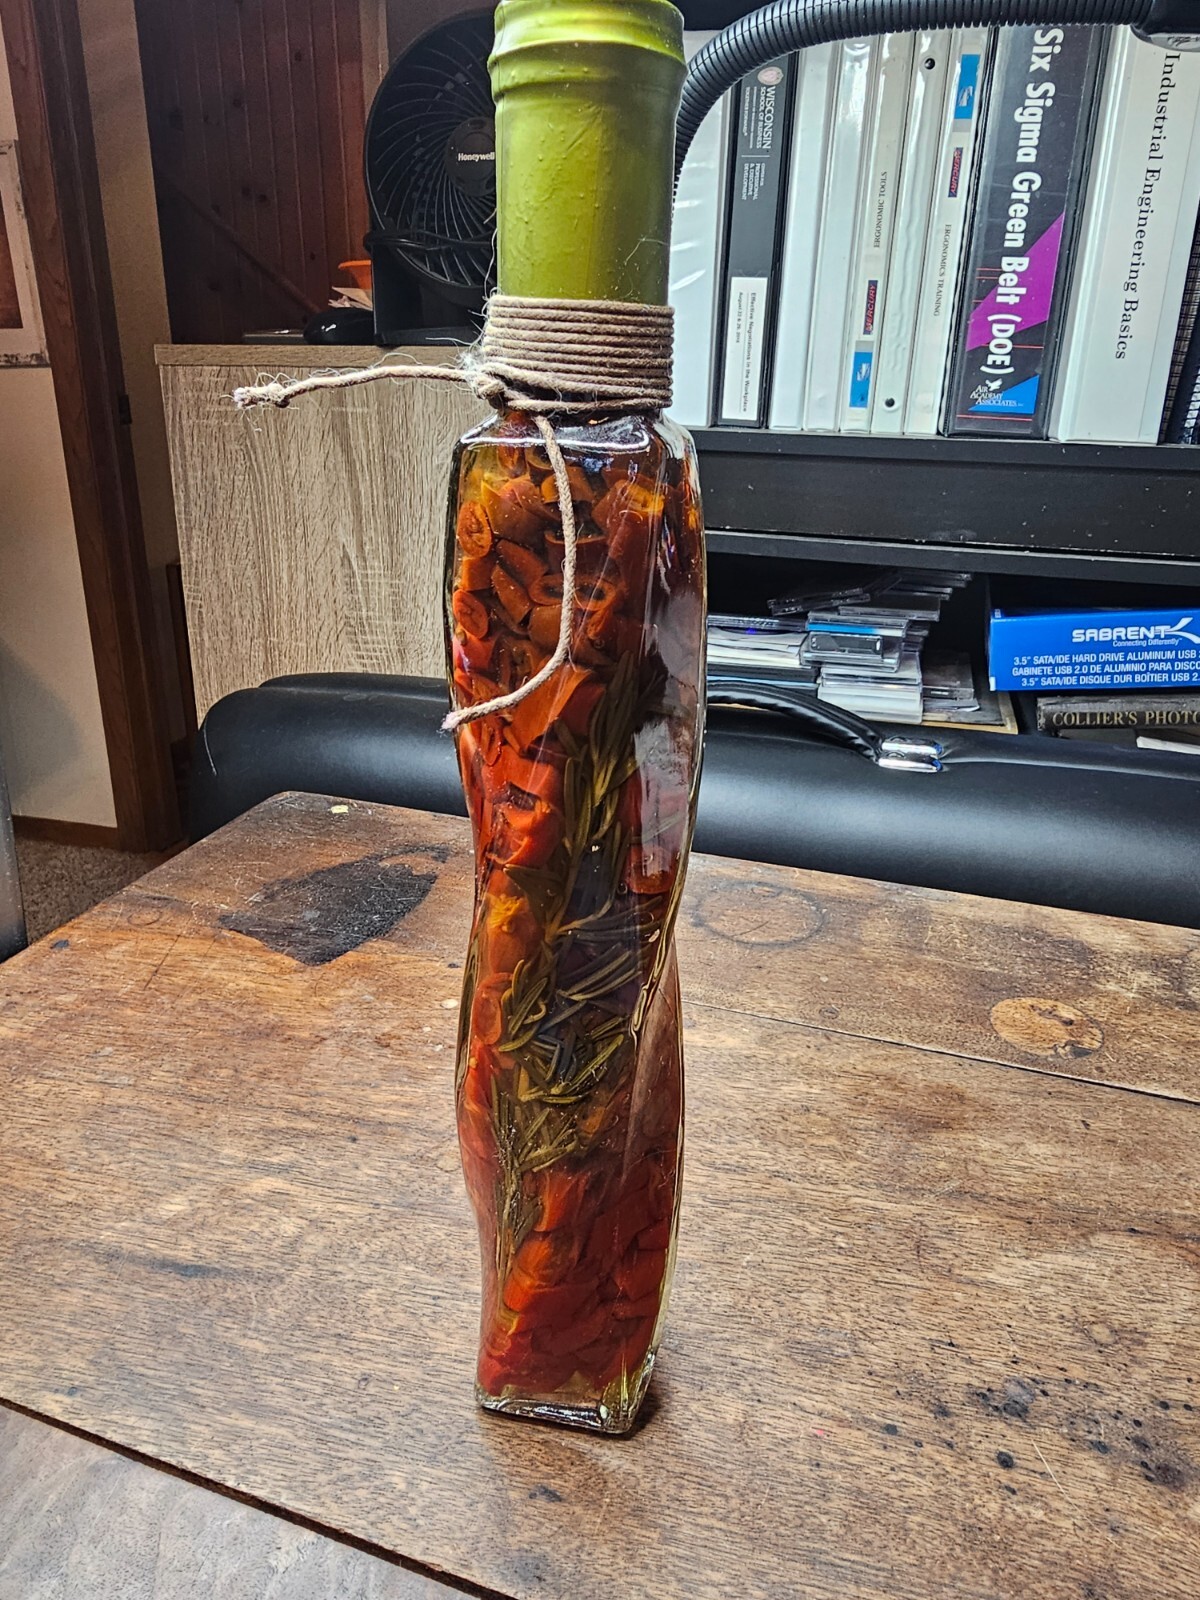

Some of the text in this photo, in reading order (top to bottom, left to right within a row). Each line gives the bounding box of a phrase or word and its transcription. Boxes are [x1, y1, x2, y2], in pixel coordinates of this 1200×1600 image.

[762, 86, 776, 148] WISCONSIN
[458, 152, 495, 162] Honeywell
[874, 171, 887, 248] ERGONOMIC TOOLS
[980, 27, 1065, 374] Six Sigma Green Belt (DOE)
[1115, 53, 1180, 359] Industrial Engineering Basics
[934, 224, 952, 316] ERGONOMICS TRAINING
[866, 284, 876, 331] MERCURY
[746, 322, 754, 360] Negotiations
[970, 391, 1003, 399] ACADEMY
[1072, 625, 1170, 642] SABRENT
[1012, 666, 1052, 676] GABINETE
[1055, 666, 1072, 674] USB
[1090, 665, 1101, 673] DE
[1104, 663, 1146, 672] ALUMINIO
[1149, 662, 1171, 671] PARA
[1033, 655, 1070, 664] SATA/IDE
[1072, 654, 1096, 662] HARD
[1099, 653, 1124, 662] DRIVE
[1128, 651, 1175, 661] ALUMINUM
[1178, 650, 1196, 659] USB
[1041, 676, 1077, 685] SATA/IDE
[1080, 675, 1111, 684] DISQUE
[1114, 675, 1132, 683] DUR
[1135, 672, 1168, 682] BOÎTIER
[1171, 673, 1189, 681] USB
[1053, 712, 1137, 726] COLLIER'S
